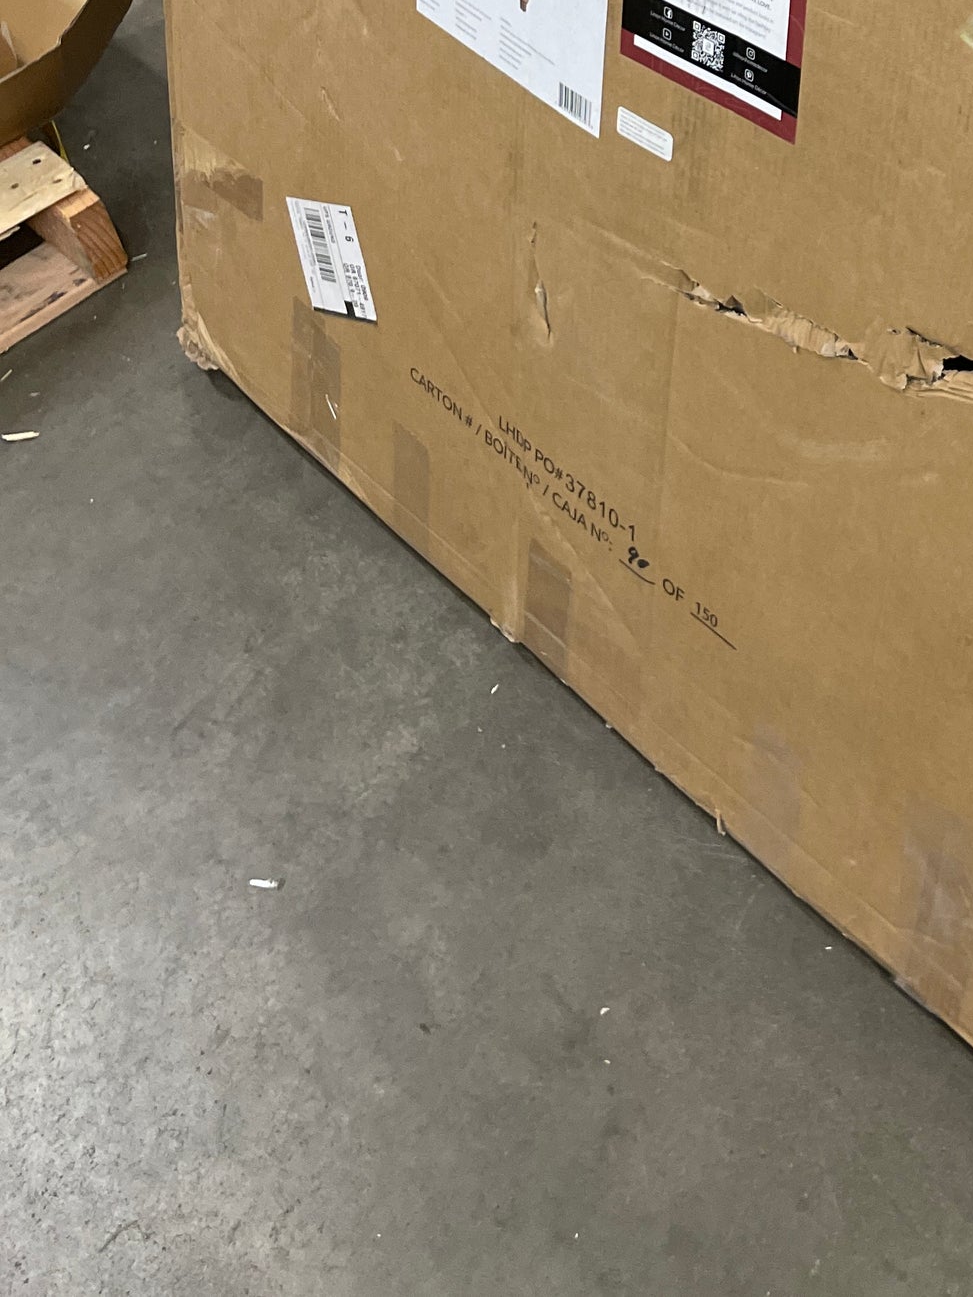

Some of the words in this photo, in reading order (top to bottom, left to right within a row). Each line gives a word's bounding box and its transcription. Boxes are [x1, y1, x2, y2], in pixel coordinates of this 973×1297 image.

[410, 367, 463, 421] CARTON
[465, 415, 473, 427] #
[476, 424, 482, 436] /
[543, 485, 550, 496] /
[552, 491, 587, 529] CAJA
[499, 415, 532, 453] LHDP
[534, 448, 636, 542] PO#37810-1
[662, 578, 685, 602] OF
[694, 601, 719, 628] 150
